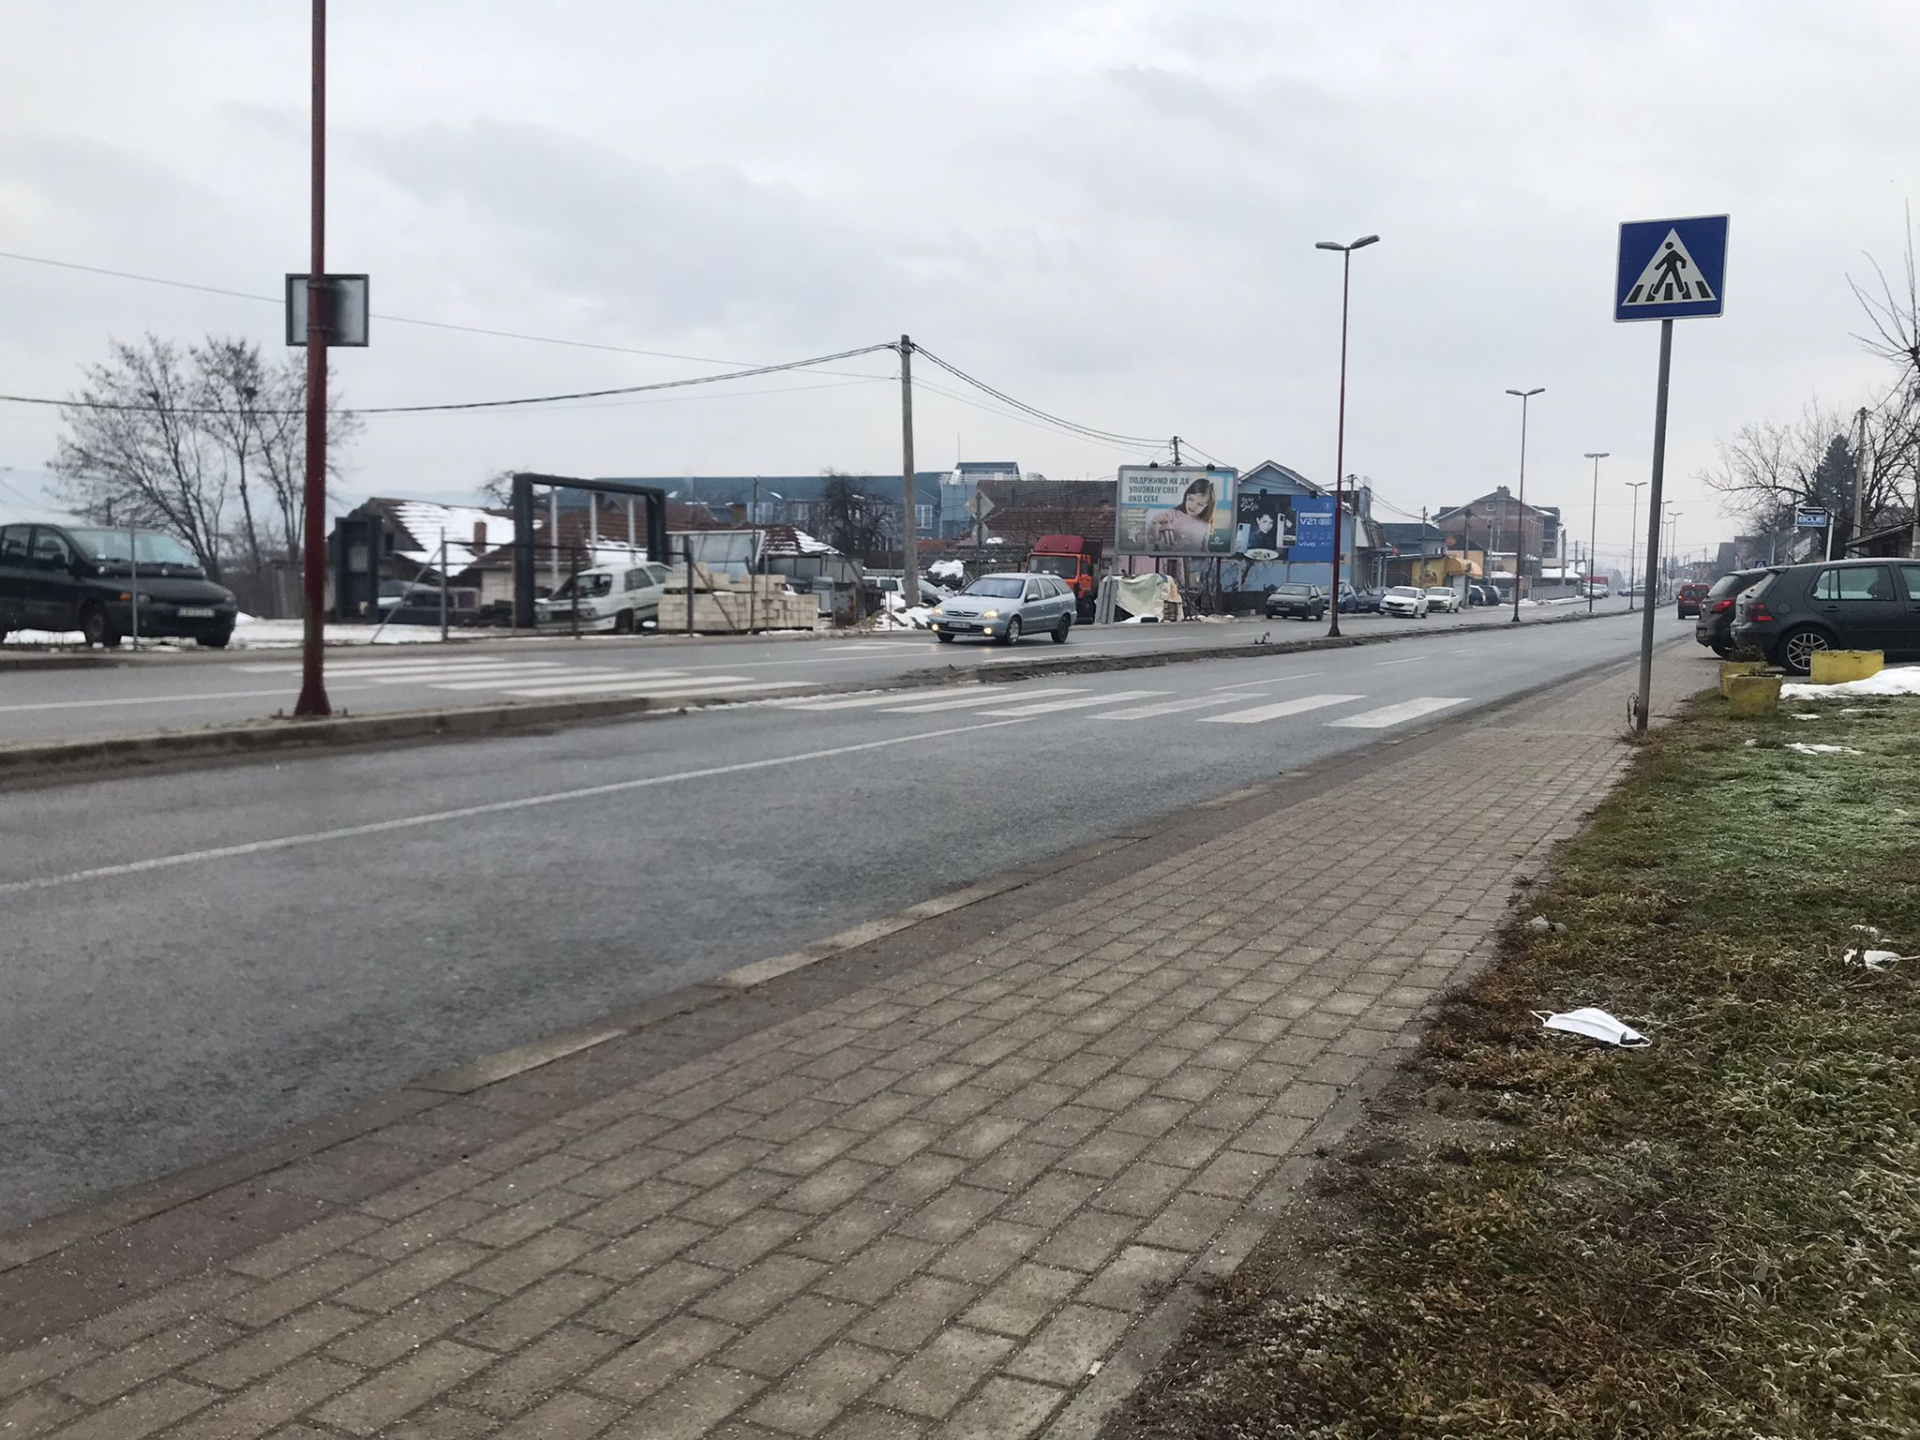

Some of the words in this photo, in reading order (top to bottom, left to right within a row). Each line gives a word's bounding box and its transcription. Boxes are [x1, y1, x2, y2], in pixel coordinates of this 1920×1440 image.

[1129, 477, 1168, 485] ПОДРЖИМО
[1179, 478, 1189, 486] ДА
[1162, 486, 1178, 494] СВЕТ
[1128, 495, 1142, 503] ОКО
[1143, 495, 1159, 503] СЕБЕ
